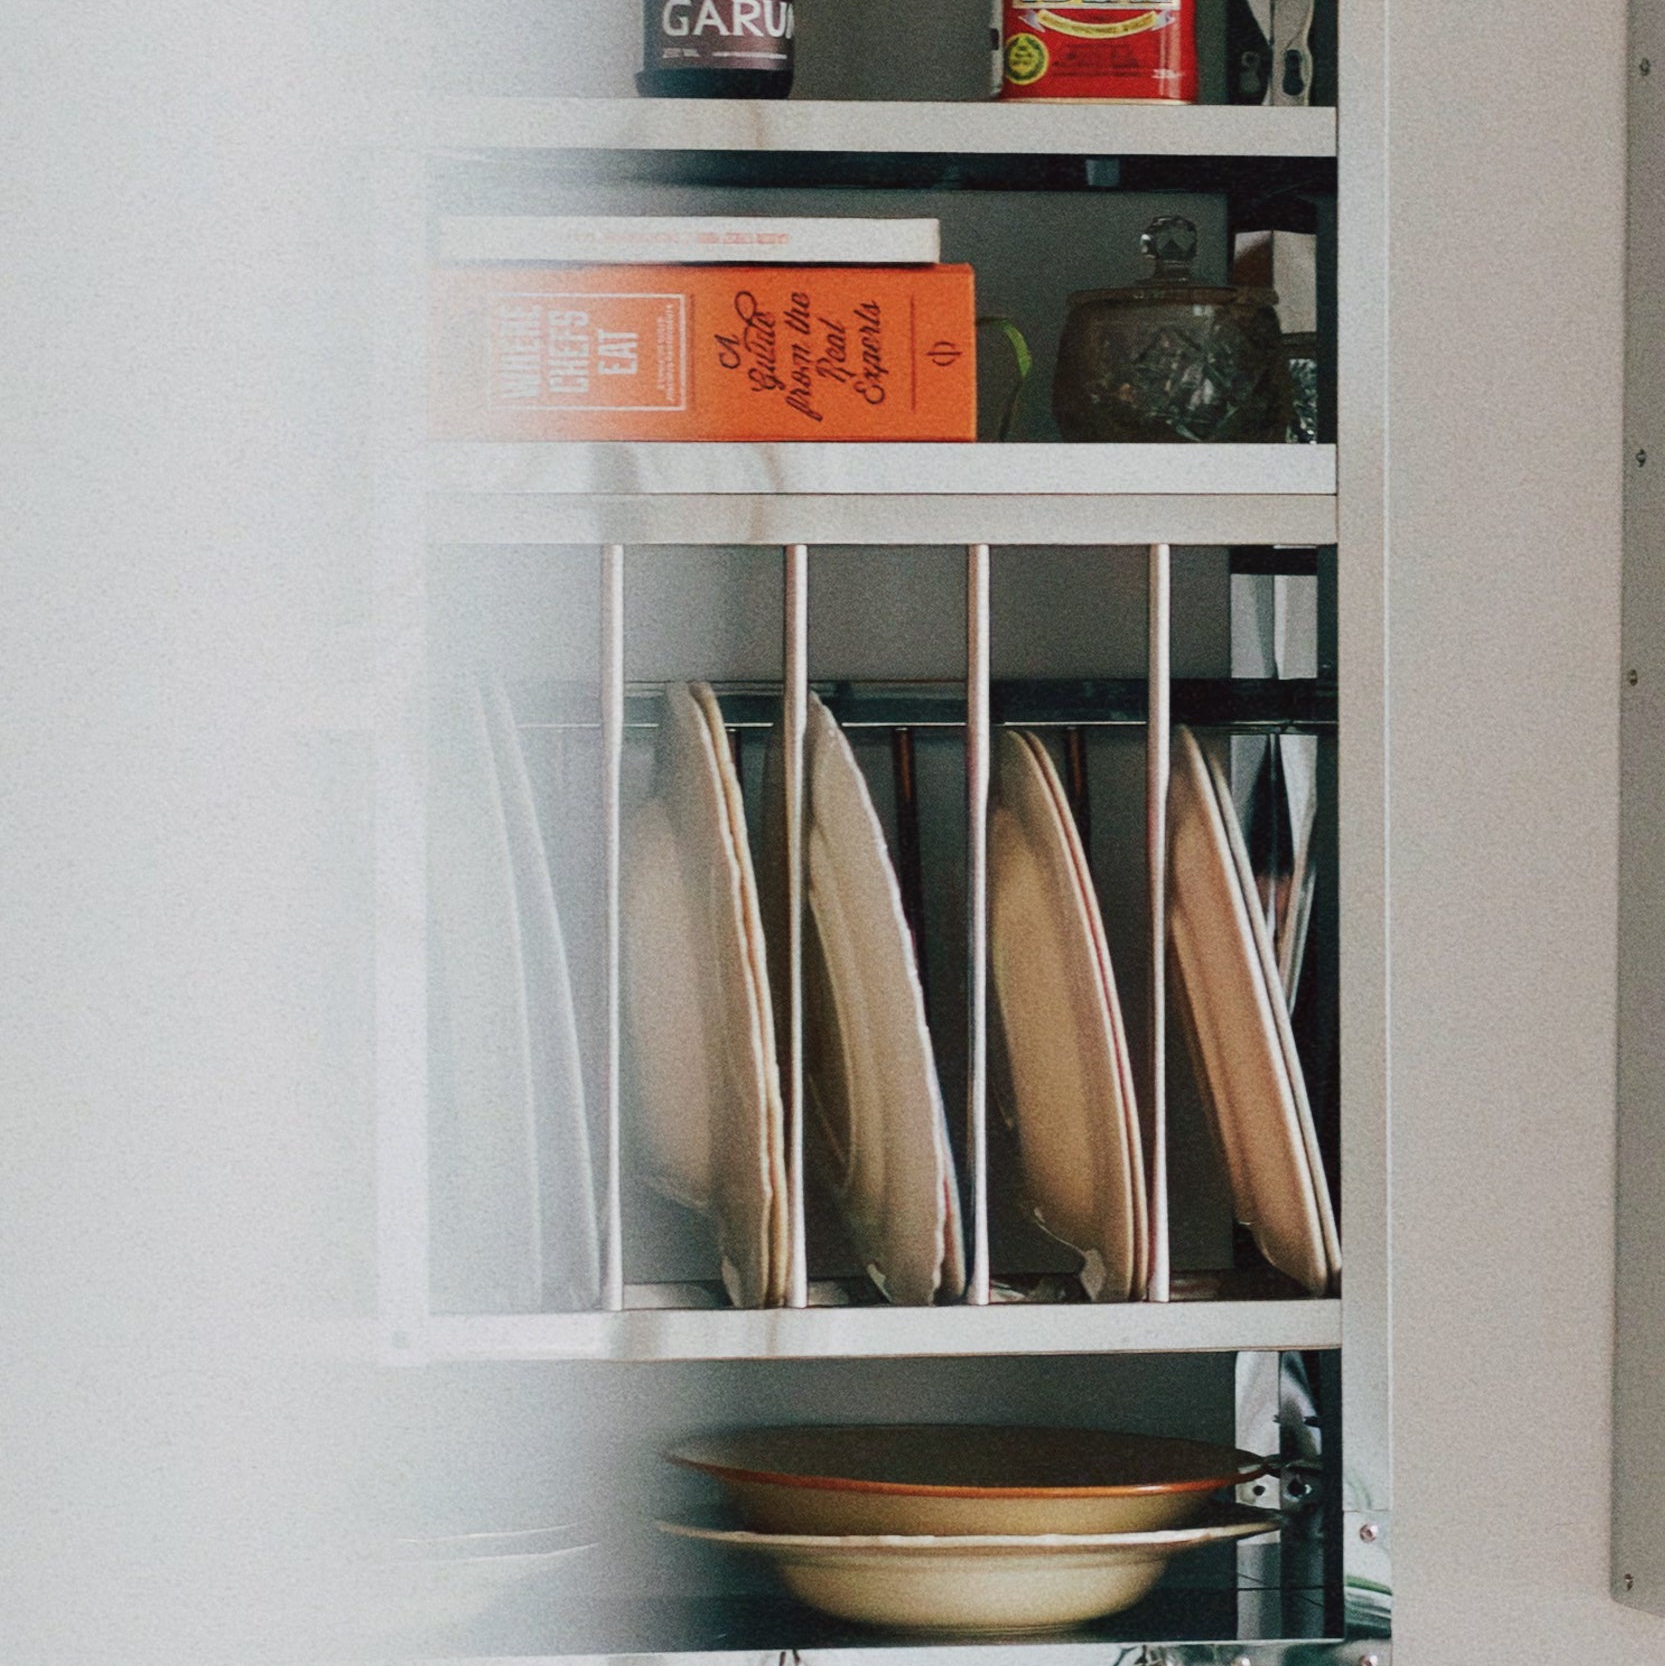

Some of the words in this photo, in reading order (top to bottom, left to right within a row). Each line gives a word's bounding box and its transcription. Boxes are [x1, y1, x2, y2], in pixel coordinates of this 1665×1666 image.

[499, 304, 541, 401] WHERE
[548, 310, 590, 394] CHEFS
[596, 328, 640, 376] EAT
[713, 334, 742, 370] A
[734, 290, 787, 394] Guide
[783, 291, 812, 336] the
[814, 317, 858, 385] Real
[853, 299, 891, 406] Experts
[784, 343, 823, 422] from
